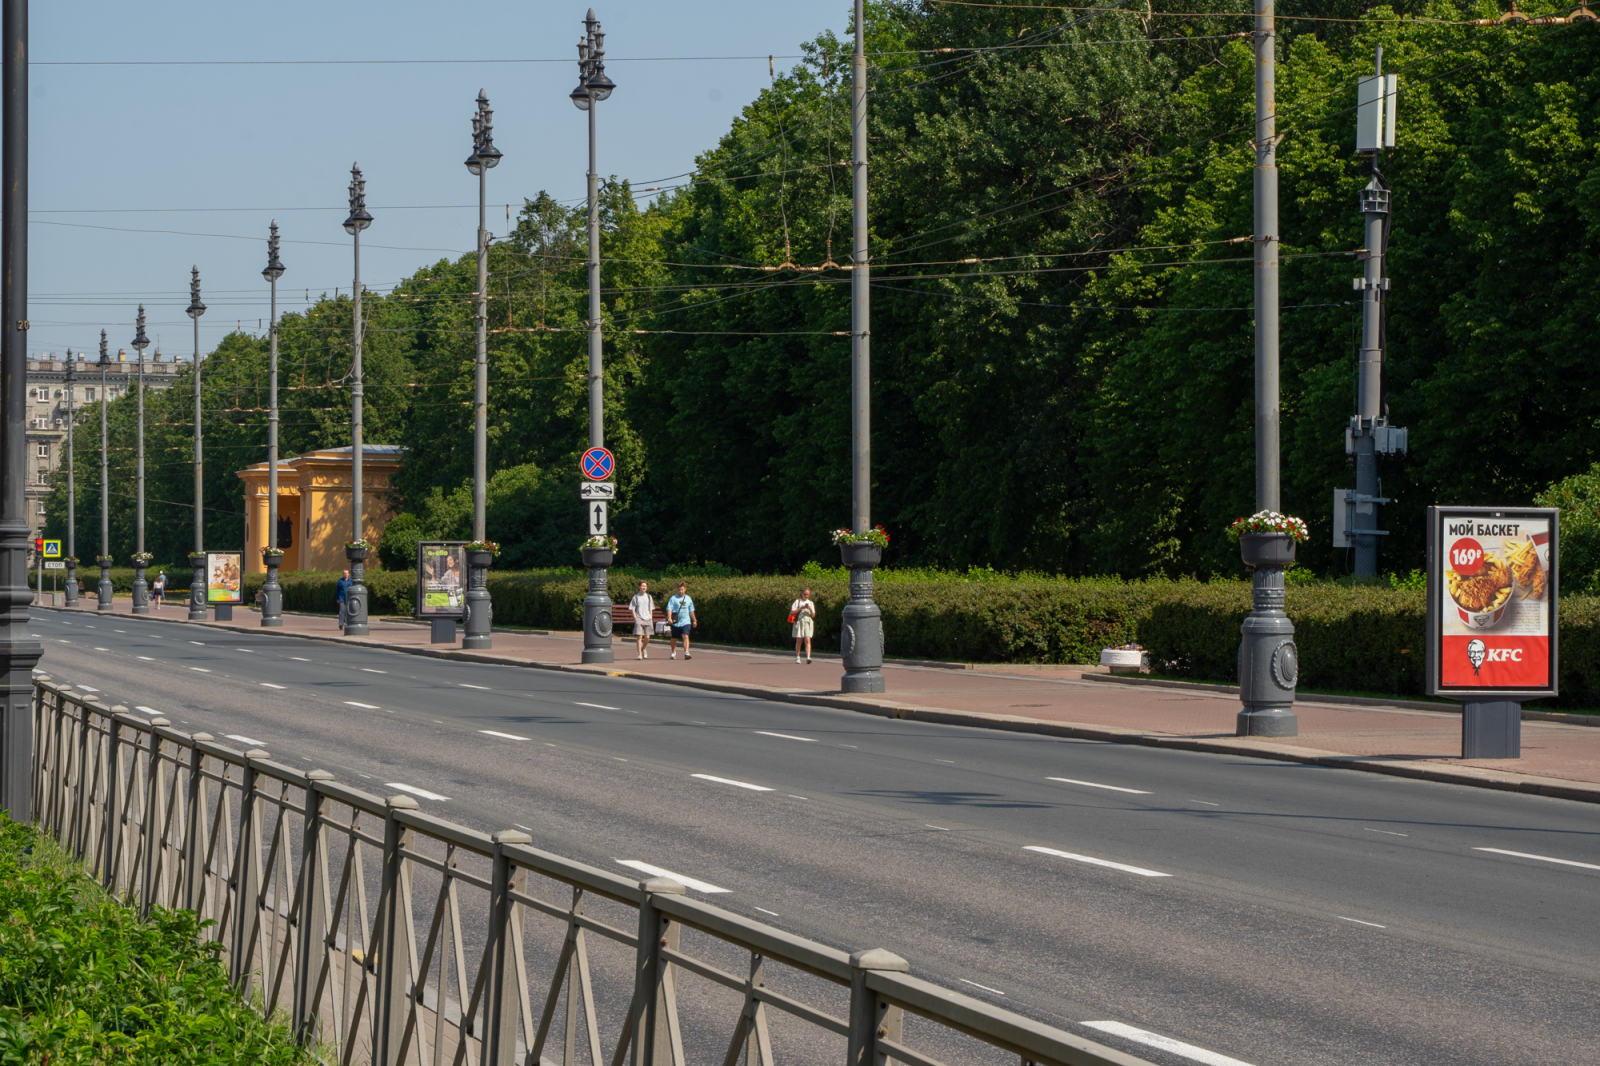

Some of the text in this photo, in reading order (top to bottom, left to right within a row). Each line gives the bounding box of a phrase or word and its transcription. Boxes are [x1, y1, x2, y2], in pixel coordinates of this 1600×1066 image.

[18, 320, 30, 330] 20
[1449, 520, 1520, 536] МОЙ БАСКЕТ
[1486, 648, 1523, 662] KFC
